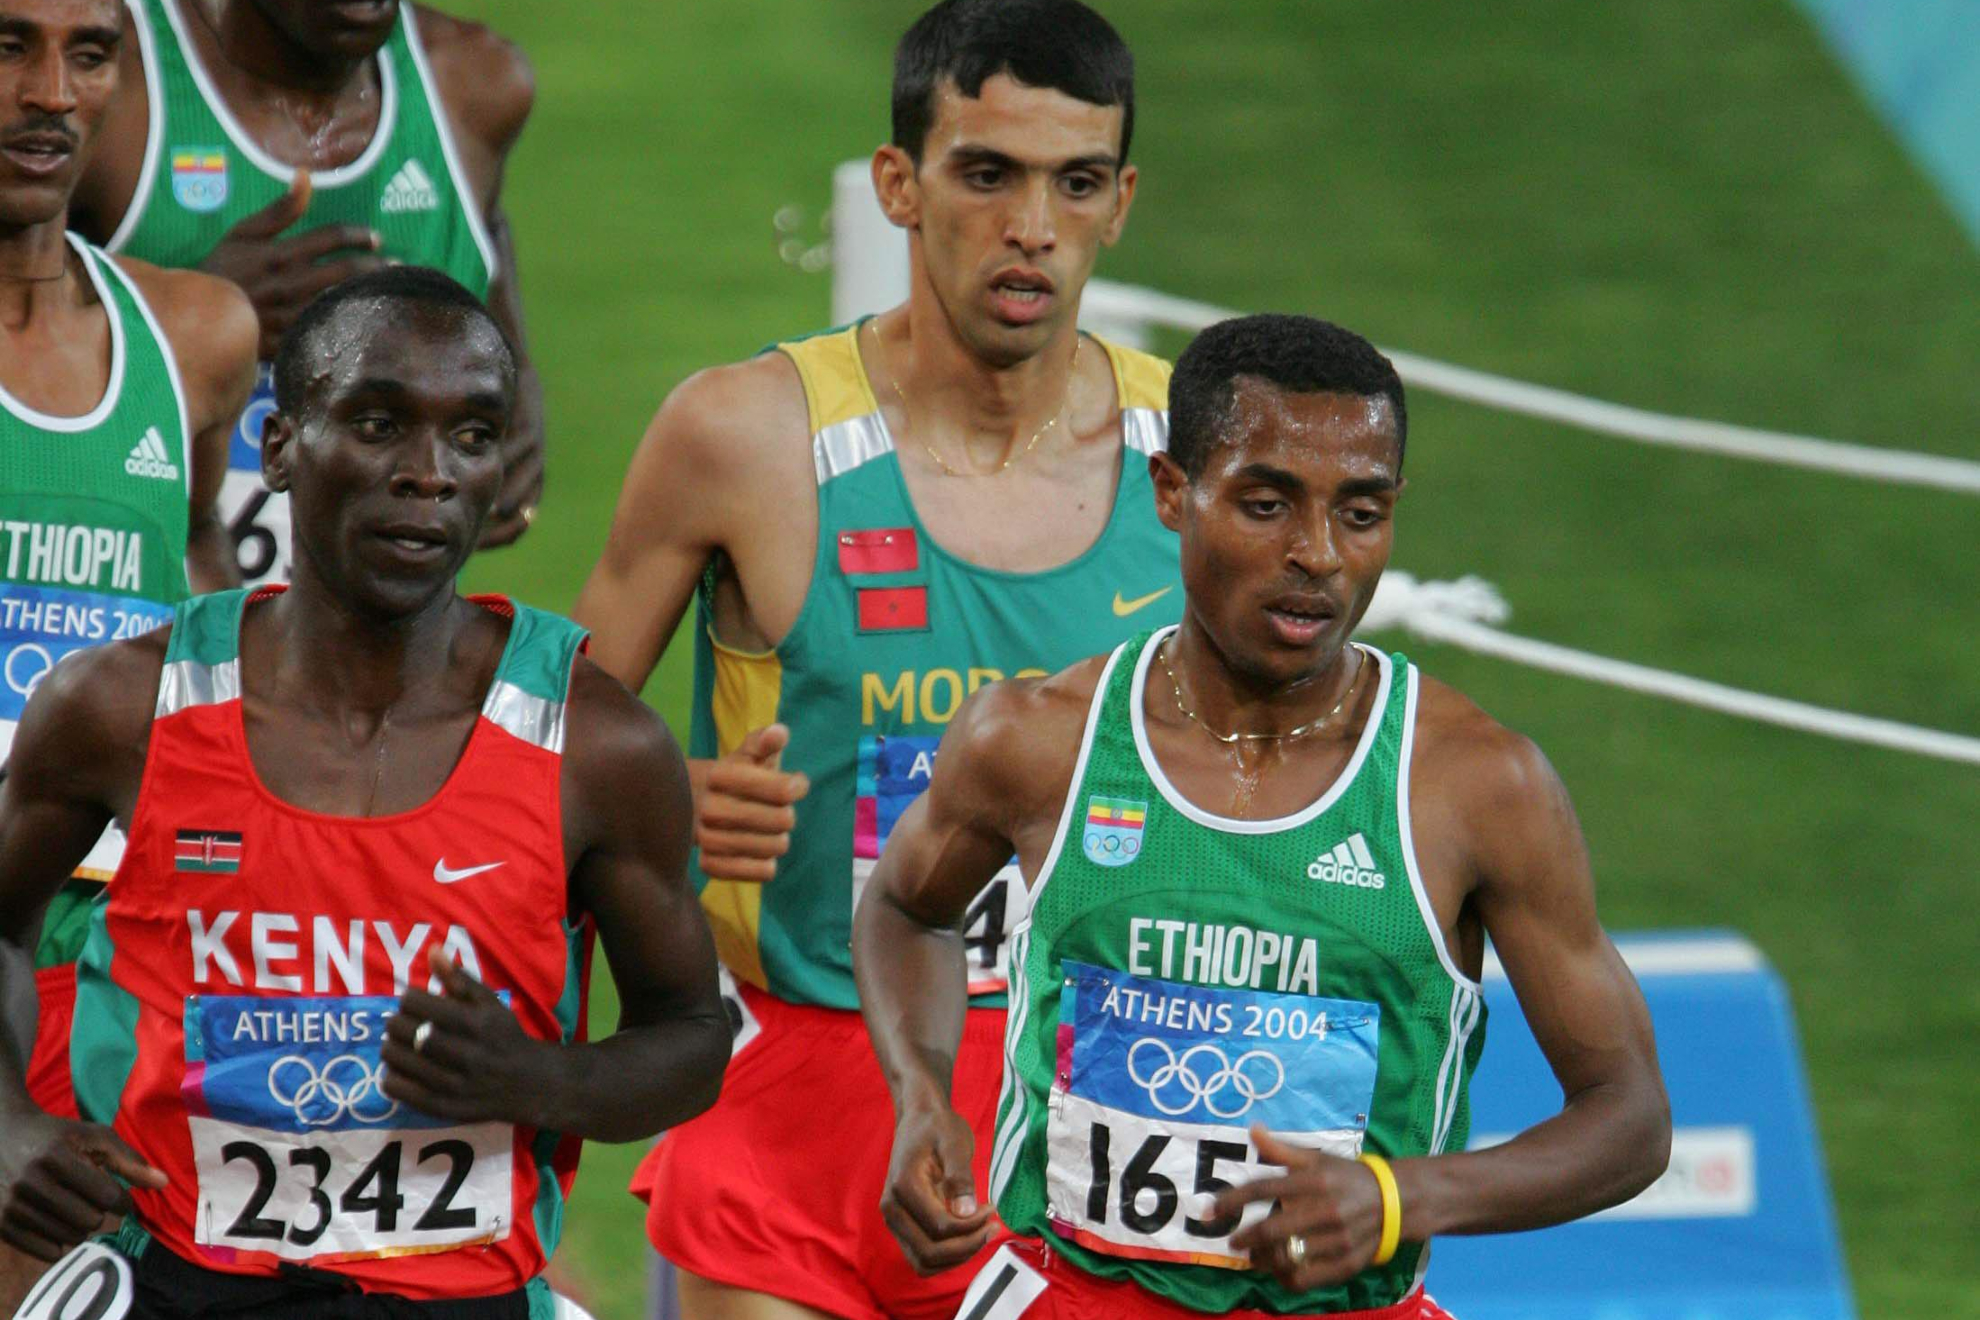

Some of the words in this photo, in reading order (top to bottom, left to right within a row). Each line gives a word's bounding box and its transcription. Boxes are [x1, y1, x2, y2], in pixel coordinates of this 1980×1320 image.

[125, 458, 178, 480] adidas
[0, 520, 142, 592] THIOPIA
[0, 597, 105, 640] THENS
[111, 611, 162, 640] 200
[861, 667, 1050, 726] MO
[907, 751, 937, 780] A
[1307, 862, 1385, 890] adidas
[186, 908, 482, 996] KENYA
[962, 879, 1006, 968] 4
[1128, 917, 1318, 996] ETHIOPIA
[232, 1010, 371, 1043] ATHENS
[1101, 986, 1233, 1034] ATHENS
[1242, 1005, 1328, 1041] 2004
[221, 1138, 477, 1247] 2342
